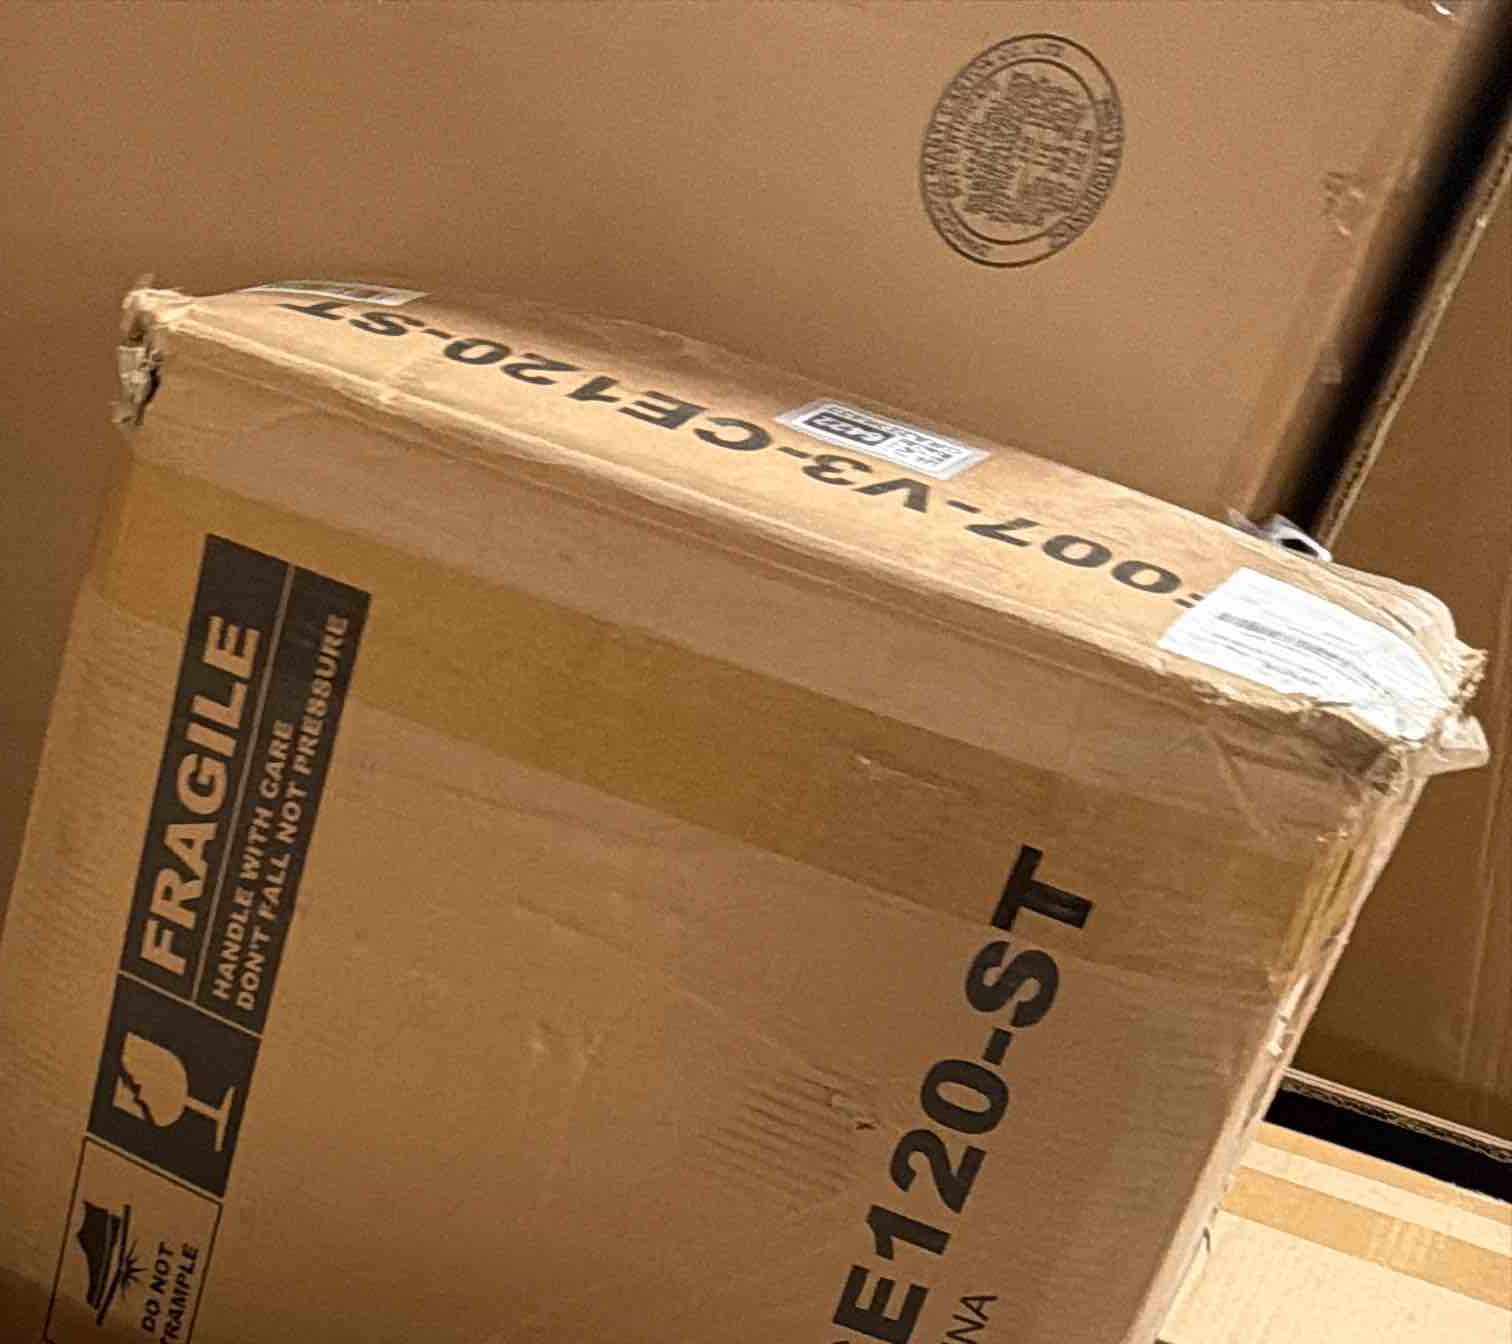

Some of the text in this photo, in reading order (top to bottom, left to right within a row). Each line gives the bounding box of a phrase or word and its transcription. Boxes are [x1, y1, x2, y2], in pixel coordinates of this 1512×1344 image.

[142, 616, 261, 977] FRAGILE
[213, 718, 294, 1000] HANDLE WITH CARE
[236, 614, 349, 1010] DON'T FALL NOT PRESSURE
[142, 1242, 174, 1333] DO NOT
